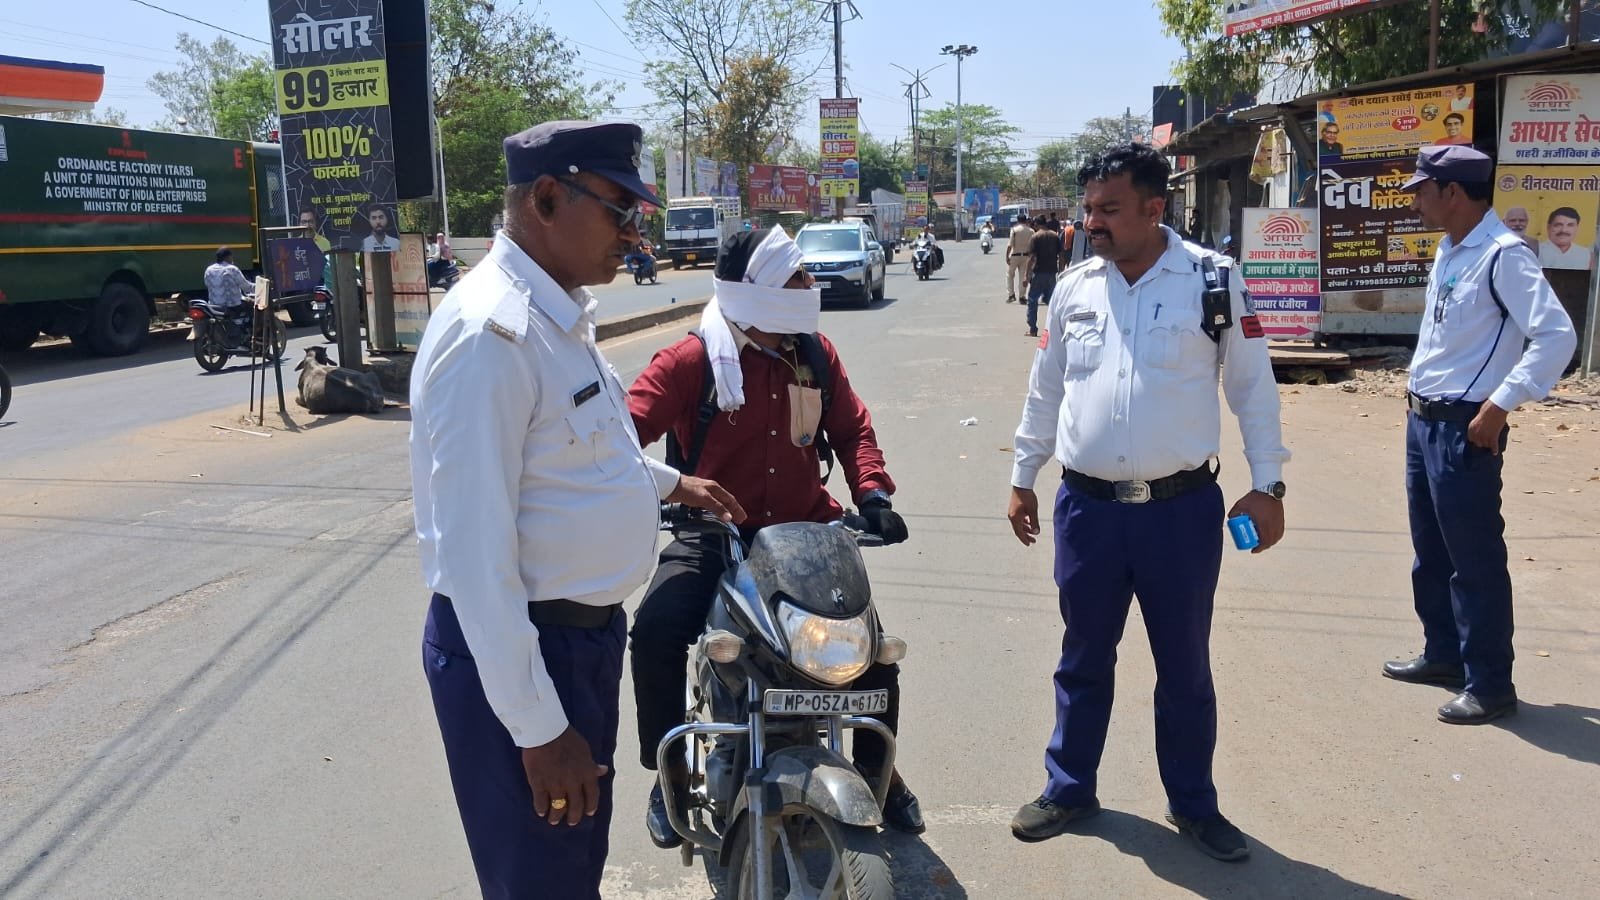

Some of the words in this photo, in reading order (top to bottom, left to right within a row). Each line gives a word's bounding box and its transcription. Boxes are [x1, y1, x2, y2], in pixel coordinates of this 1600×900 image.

[281, 12, 373, 54] सोलर
[330, 69, 335, 77] 3
[335, 69, 352, 77] किलो
[283, 69, 330, 110] 99
[331, 79, 378, 101] हजार
[1349, 97, 1364, 107] दीन
[1366, 96, 1389, 105] दयाल
[1392, 92, 1411, 102] रसोई
[1414, 90, 1442, 100] योजना
[1528, 101, 1572, 109] आधार
[822, 131, 848, 141] सोलर
[1508, 121, 1570, 143] आधार
[825, 142, 840, 153] 99
[1516, 147, 1540, 159] शहरी
[233, 148, 244, 168] E
[58, 157, 117, 172] ORDNANCE
[120, 161, 162, 174] FACTORY
[165, 164, 194, 177] ITARSI
[44, 171, 52, 183] A
[53, 172, 78, 184] UNIT
[80, 173, 94, 185] OF
[95, 174, 148, 188] MUNITIONS
[150, 177, 174, 189] INDIA
[175, 178, 207, 190] LIMITED
[1521, 174, 1575, 191] दीनदयाल
[1579, 174, 1600, 191] रसो
[45, 187, 53, 198] A
[55, 187, 117, 200] GOVERNMENT
[119, 189, 130, 200] OF
[132, 190, 155, 201] INDIA
[156, 190, 207, 202] ENTERPRISES
[1321, 168, 1374, 209] देव
[758, 192, 797, 204] EKLAVYA
[84, 201, 128, 212] MINISTRY
[130, 202, 142, 212] OF
[144, 203, 183, 214] DEFENCE
[1264, 234, 1305, 242] आधार
[1365, 238, 1376, 247] एवं
[1249, 250, 1276, 259] आधार
[1279, 248, 1296, 259] सेवा
[1298, 248, 1317, 259] केन्द्र
[1246, 265, 1271, 275] आधार
[1271, 263, 1288, 275] कार्ड
[1289, 263, 1297, 275] में
[1298, 265, 1318, 278] सुधार
[1359, 265, 1370, 274] 13
[1290, 281, 1315, 293] अपडेट
[1254, 299, 1277, 309] आधार
[1279, 297, 1308, 310] पंजीयन
[784, 694, 805, 711] MP
[812, 695, 850, 712] 05ZA
[858, 693, 887, 711] 6176
